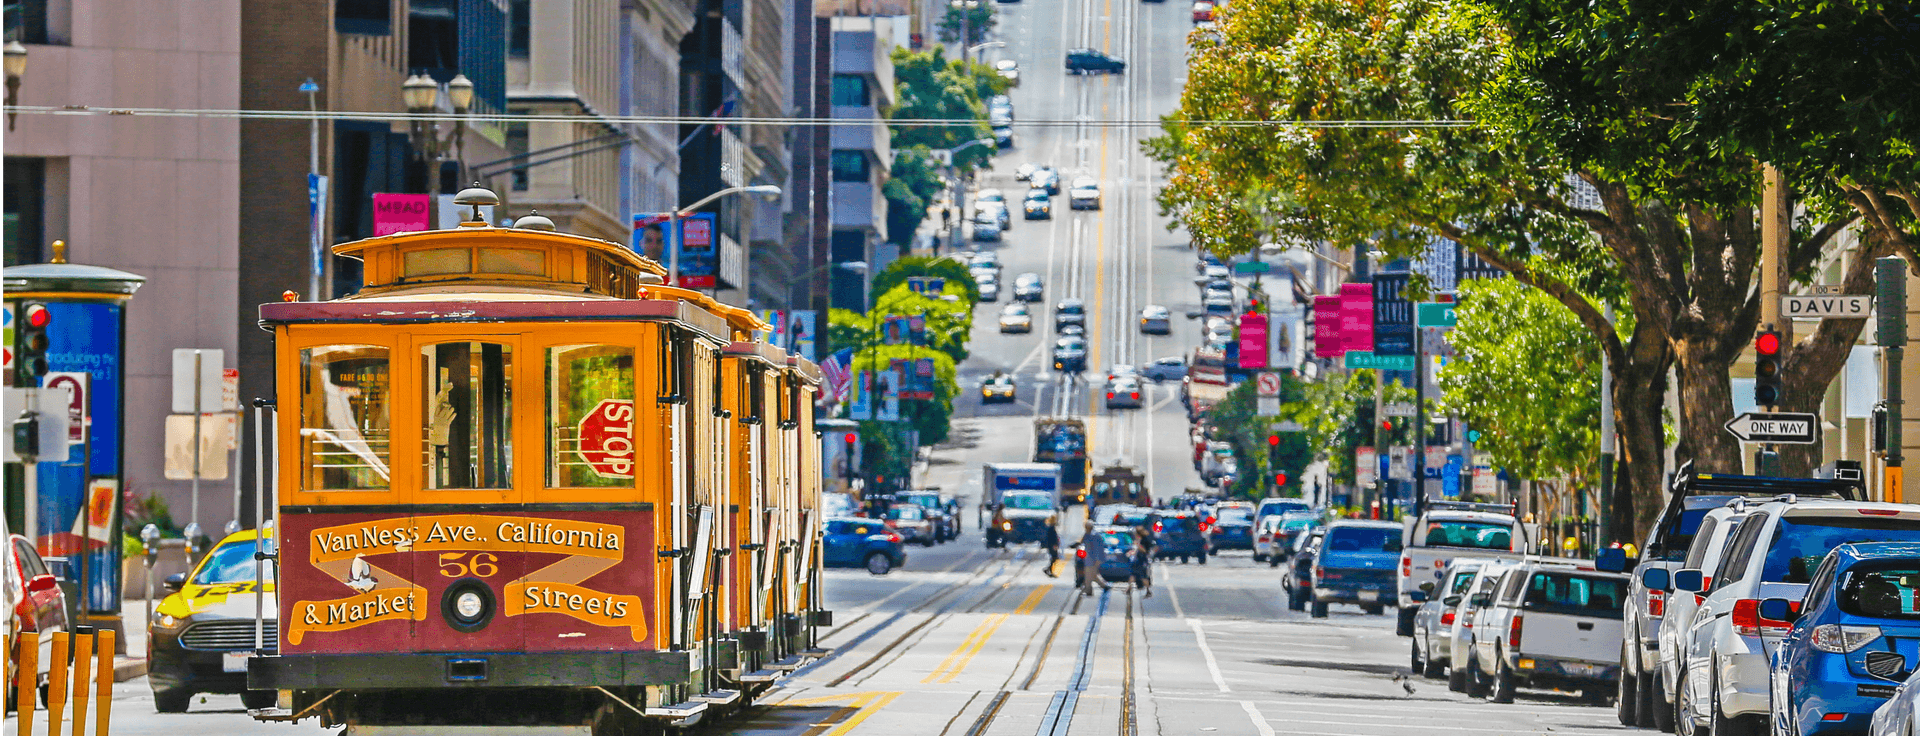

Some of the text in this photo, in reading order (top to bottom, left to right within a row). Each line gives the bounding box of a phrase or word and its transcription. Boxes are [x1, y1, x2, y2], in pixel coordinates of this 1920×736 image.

[1815, 286, 1828, 294] 100
[1790, 299, 1861, 313] DAVIS
[603, 404, 633, 474] STOP
[1750, 421, 1804, 434] ONE WAY
[316, 532, 358, 555] Van
[361, 525, 420, 547] Ness
[496, 521, 620, 551] California
[438, 553, 499, 577] 56
[304, 586, 628, 626] & Market Streets
